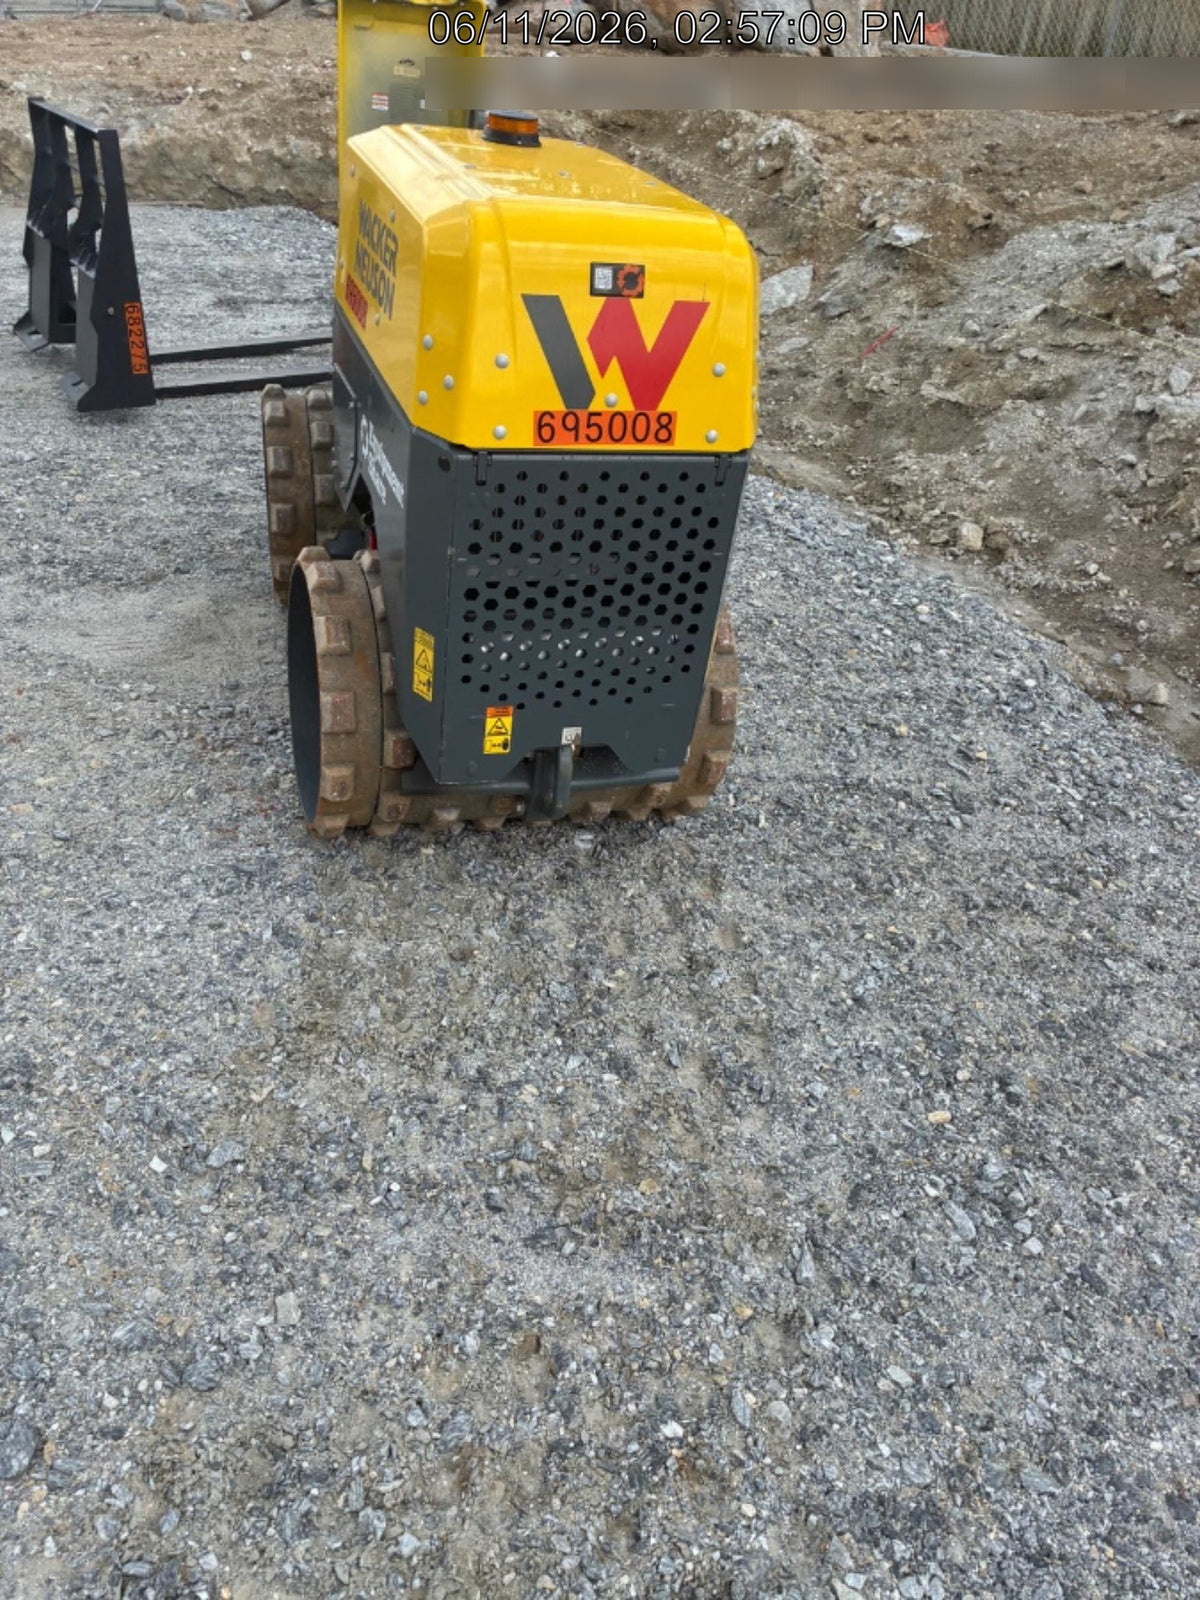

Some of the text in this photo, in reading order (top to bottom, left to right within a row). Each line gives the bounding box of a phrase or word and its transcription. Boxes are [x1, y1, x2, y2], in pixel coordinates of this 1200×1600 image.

[359, 198, 399, 280] WACKER
[354, 237, 396, 321] NEUSON
[126, 304, 147, 372] 682275
[536, 410, 673, 444] 695008
